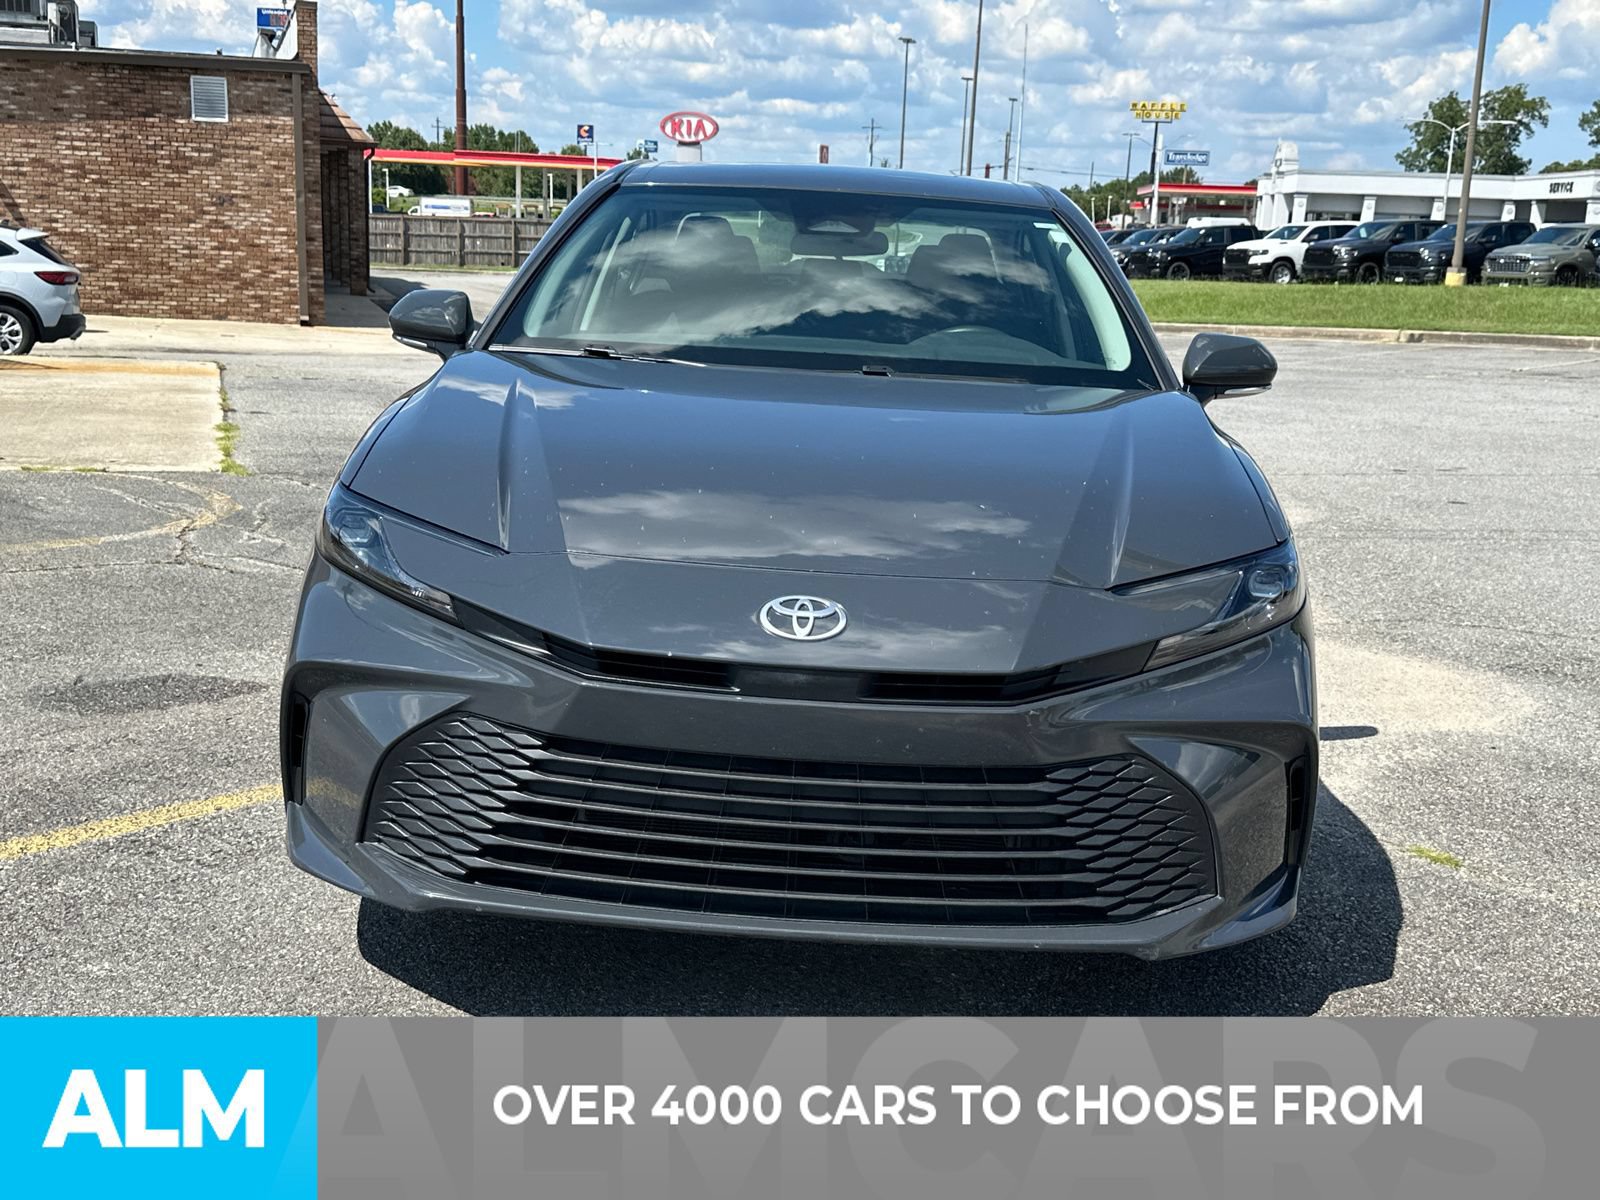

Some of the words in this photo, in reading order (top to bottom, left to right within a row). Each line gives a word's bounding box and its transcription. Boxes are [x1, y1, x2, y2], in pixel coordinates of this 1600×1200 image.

[1131, 101, 1187, 110] WAFFLE
[1135, 111, 1181, 120] HOUSE
[671, 118, 708, 138] KIA
[1549, 181, 1574, 194] SERVICE
